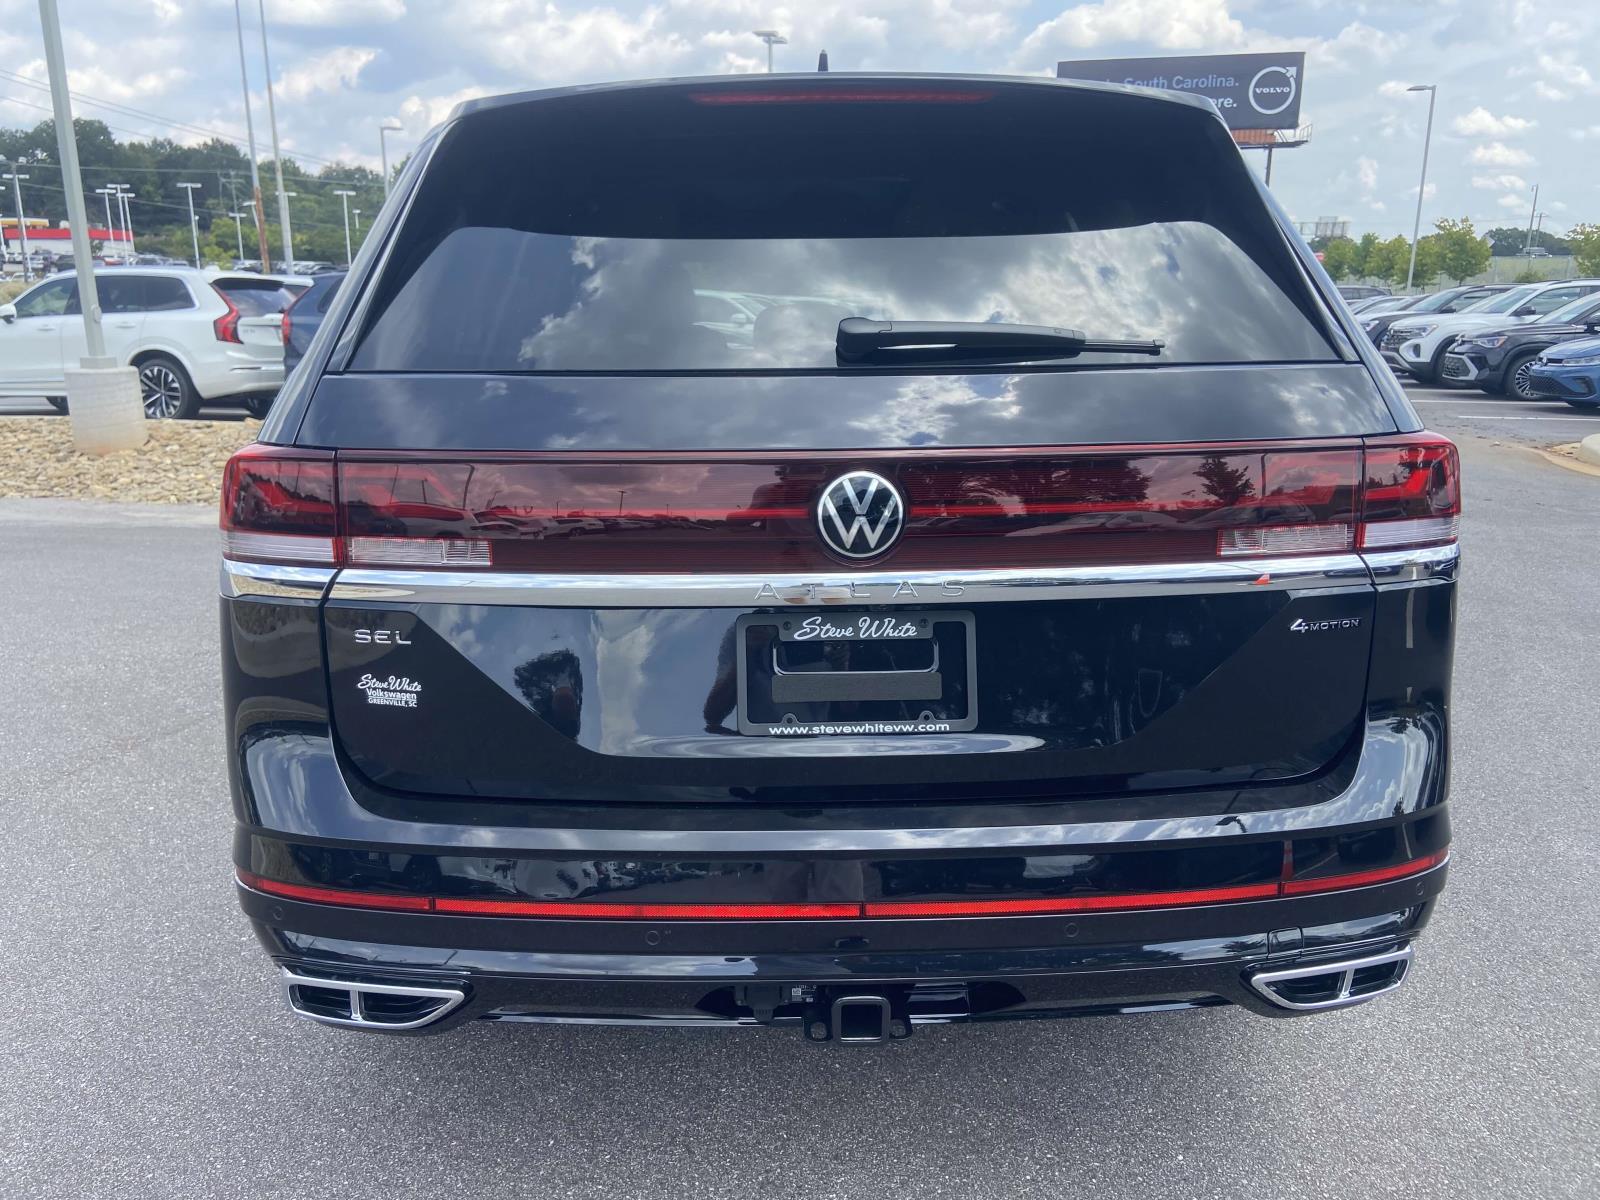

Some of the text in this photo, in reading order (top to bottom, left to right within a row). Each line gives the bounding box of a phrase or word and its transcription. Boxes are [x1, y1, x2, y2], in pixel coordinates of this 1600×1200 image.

[1172, 75, 1240, 89] Carolina.
[1254, 86, 1290, 94] VOLVO
[754, 580, 965, 601] ATLAS
[793, 616, 918, 640] Steve White
[353, 628, 412, 645] SEL
[357, 673, 422, 692] Steve White
[366, 687, 417, 701] Volkswagen
[368, 697, 418, 708] GREENVILLE, SC
[769, 722, 950, 735] www.stevewhitevw.com
